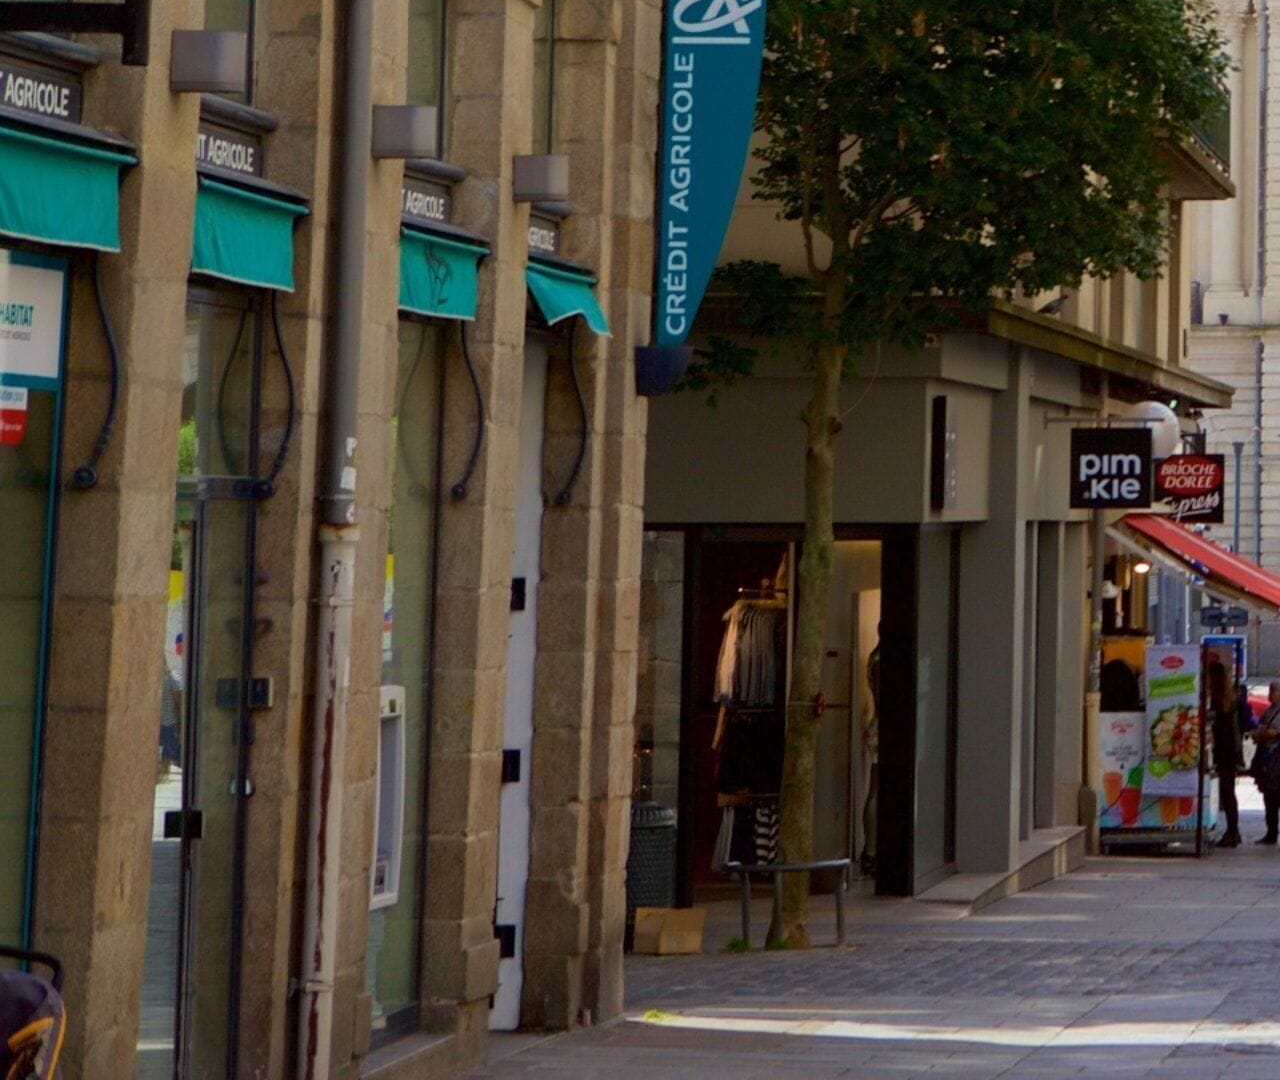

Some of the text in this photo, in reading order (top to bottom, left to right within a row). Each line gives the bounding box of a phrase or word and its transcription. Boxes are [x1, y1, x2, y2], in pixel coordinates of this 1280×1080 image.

[4, 72, 70, 117] AGRICOLE
[207, 136, 255, 173] AGRICOLE
[406, 189, 445, 220] AGRICOLE
[664, 52, 695, 335] CRÉDIT AGRICOLE
[527, 226, 555, 251] GRICOLE
[1079, 453, 1142, 482] pim
